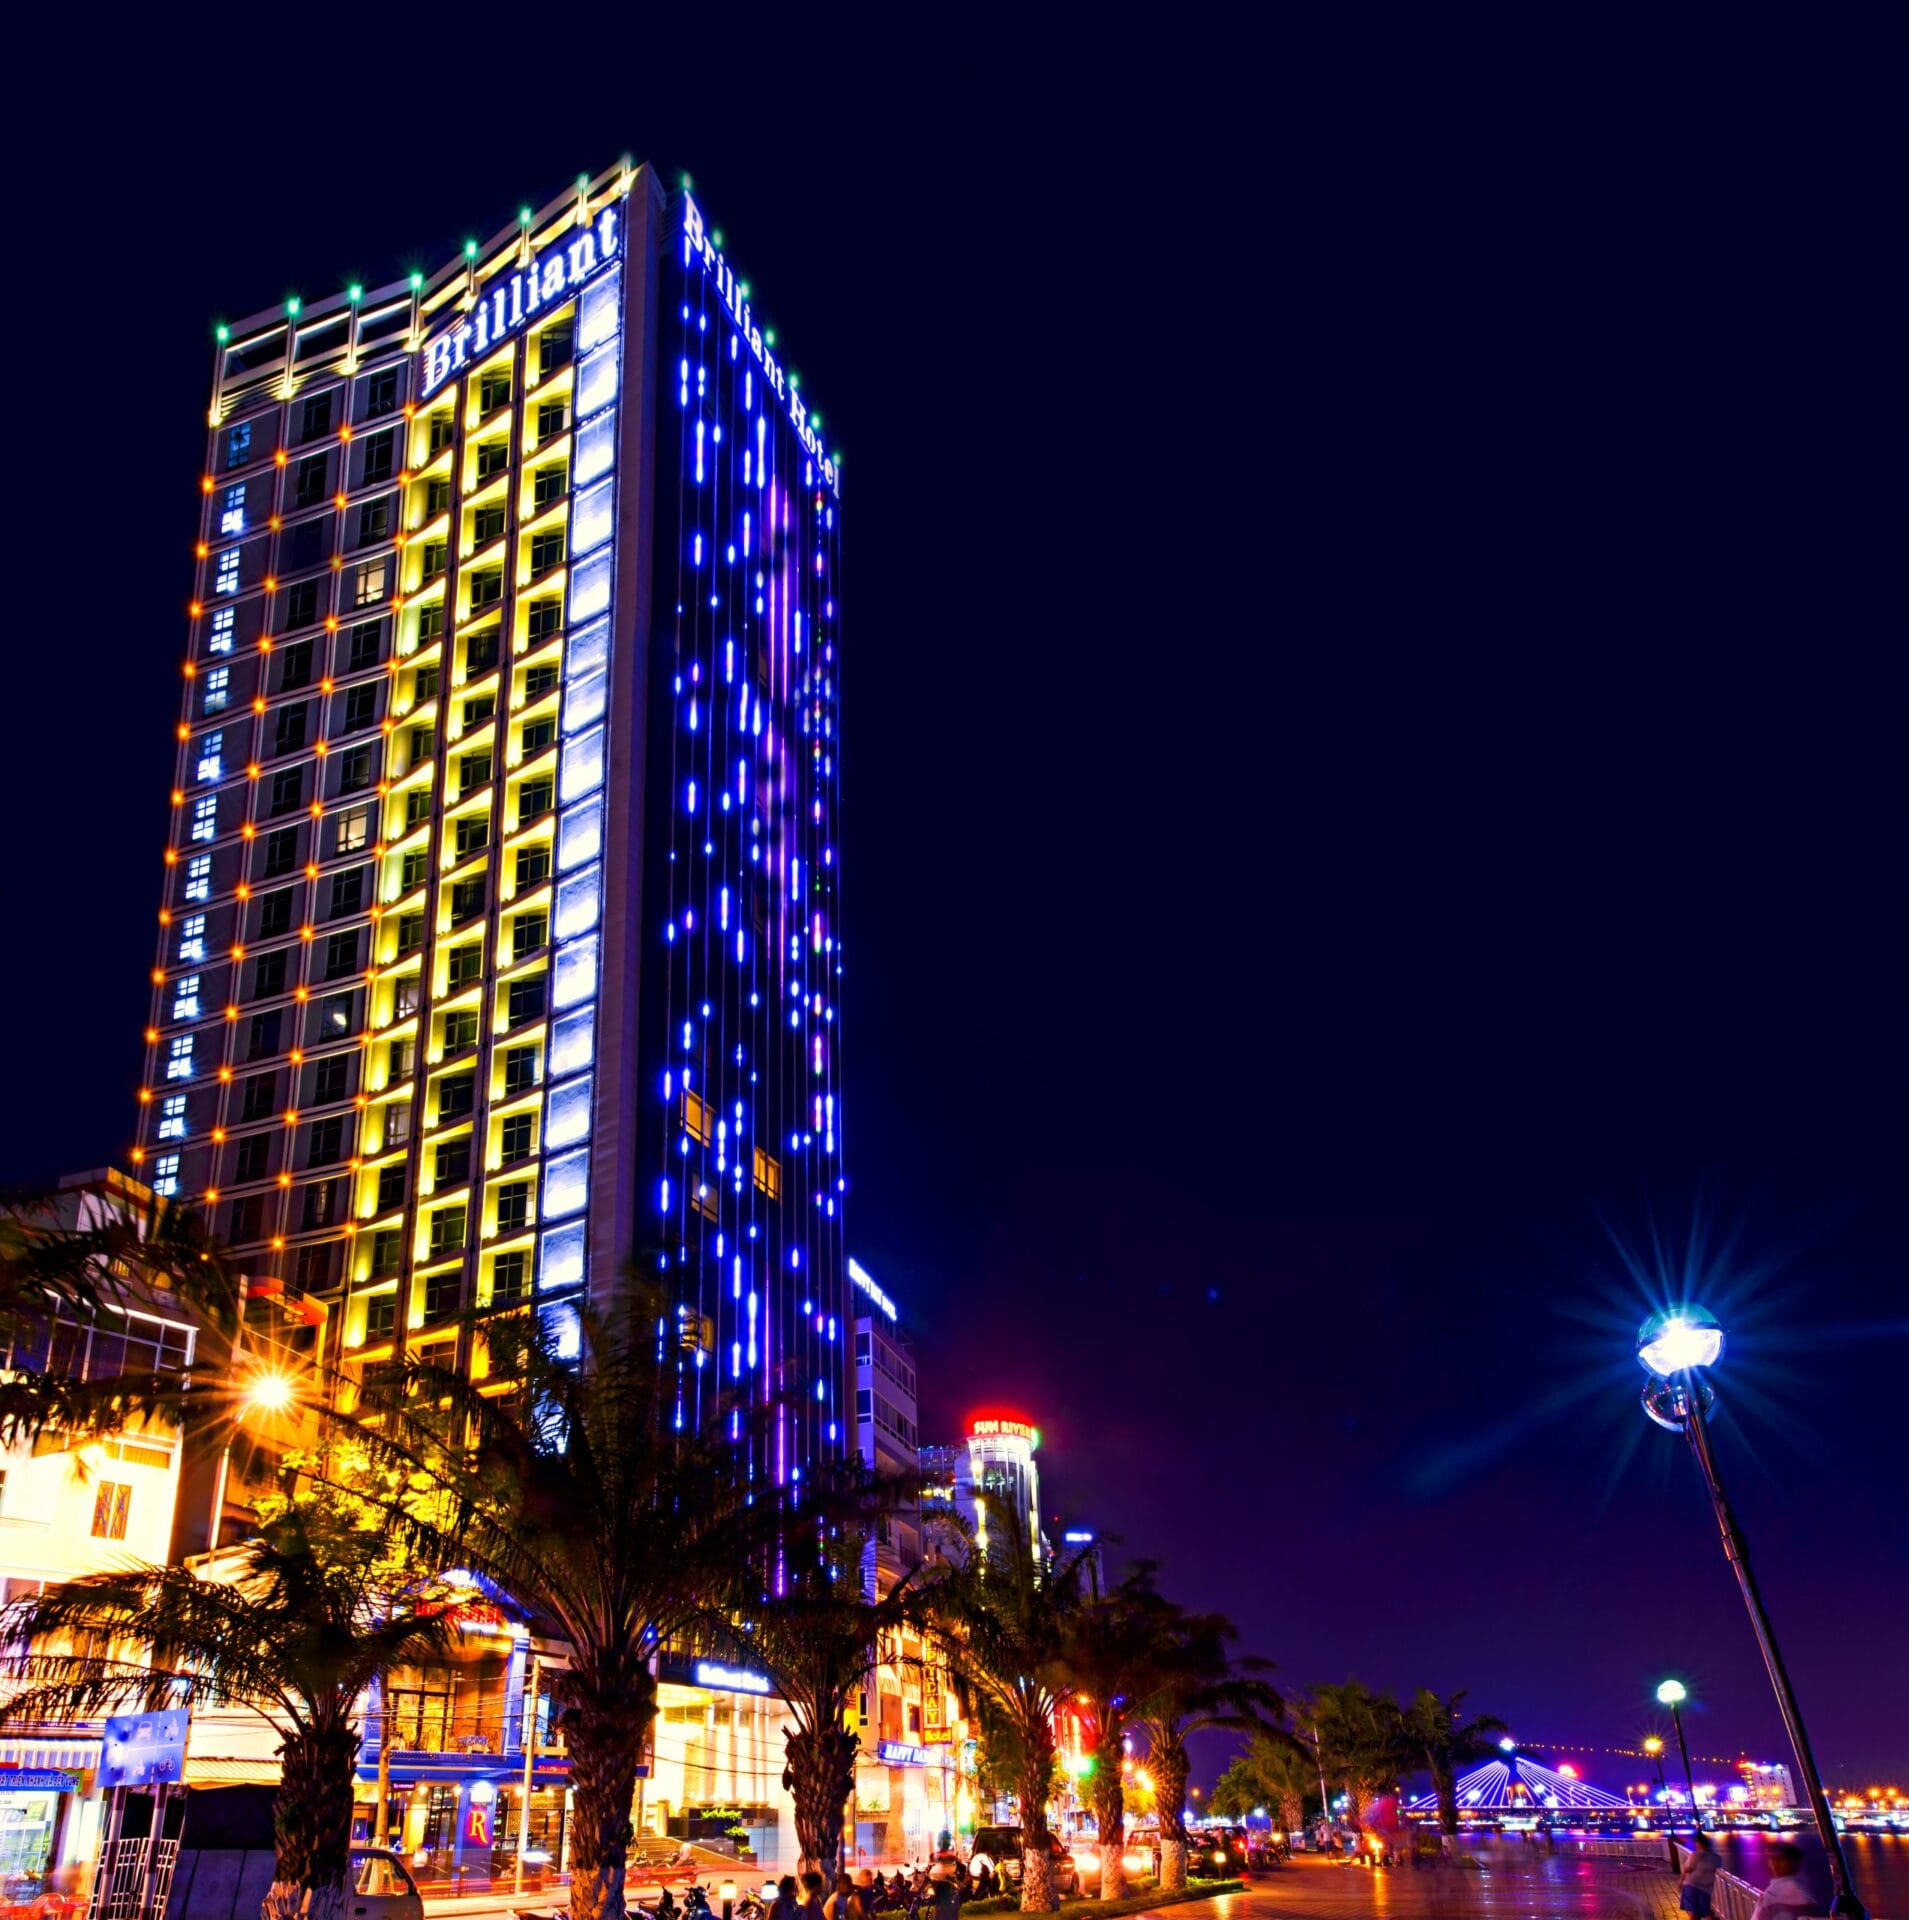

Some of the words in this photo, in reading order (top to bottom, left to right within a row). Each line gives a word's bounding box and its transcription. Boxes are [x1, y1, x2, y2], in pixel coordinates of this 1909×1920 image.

[422, 207, 618, 397] Brilliant
[684, 190, 784, 401] Brilliant
[789, 386, 840, 499] Hotel
[973, 1420, 999, 1435] SUN
[885, 1744, 913, 1761] HAPPY
[469, 1810, 489, 1844] R
